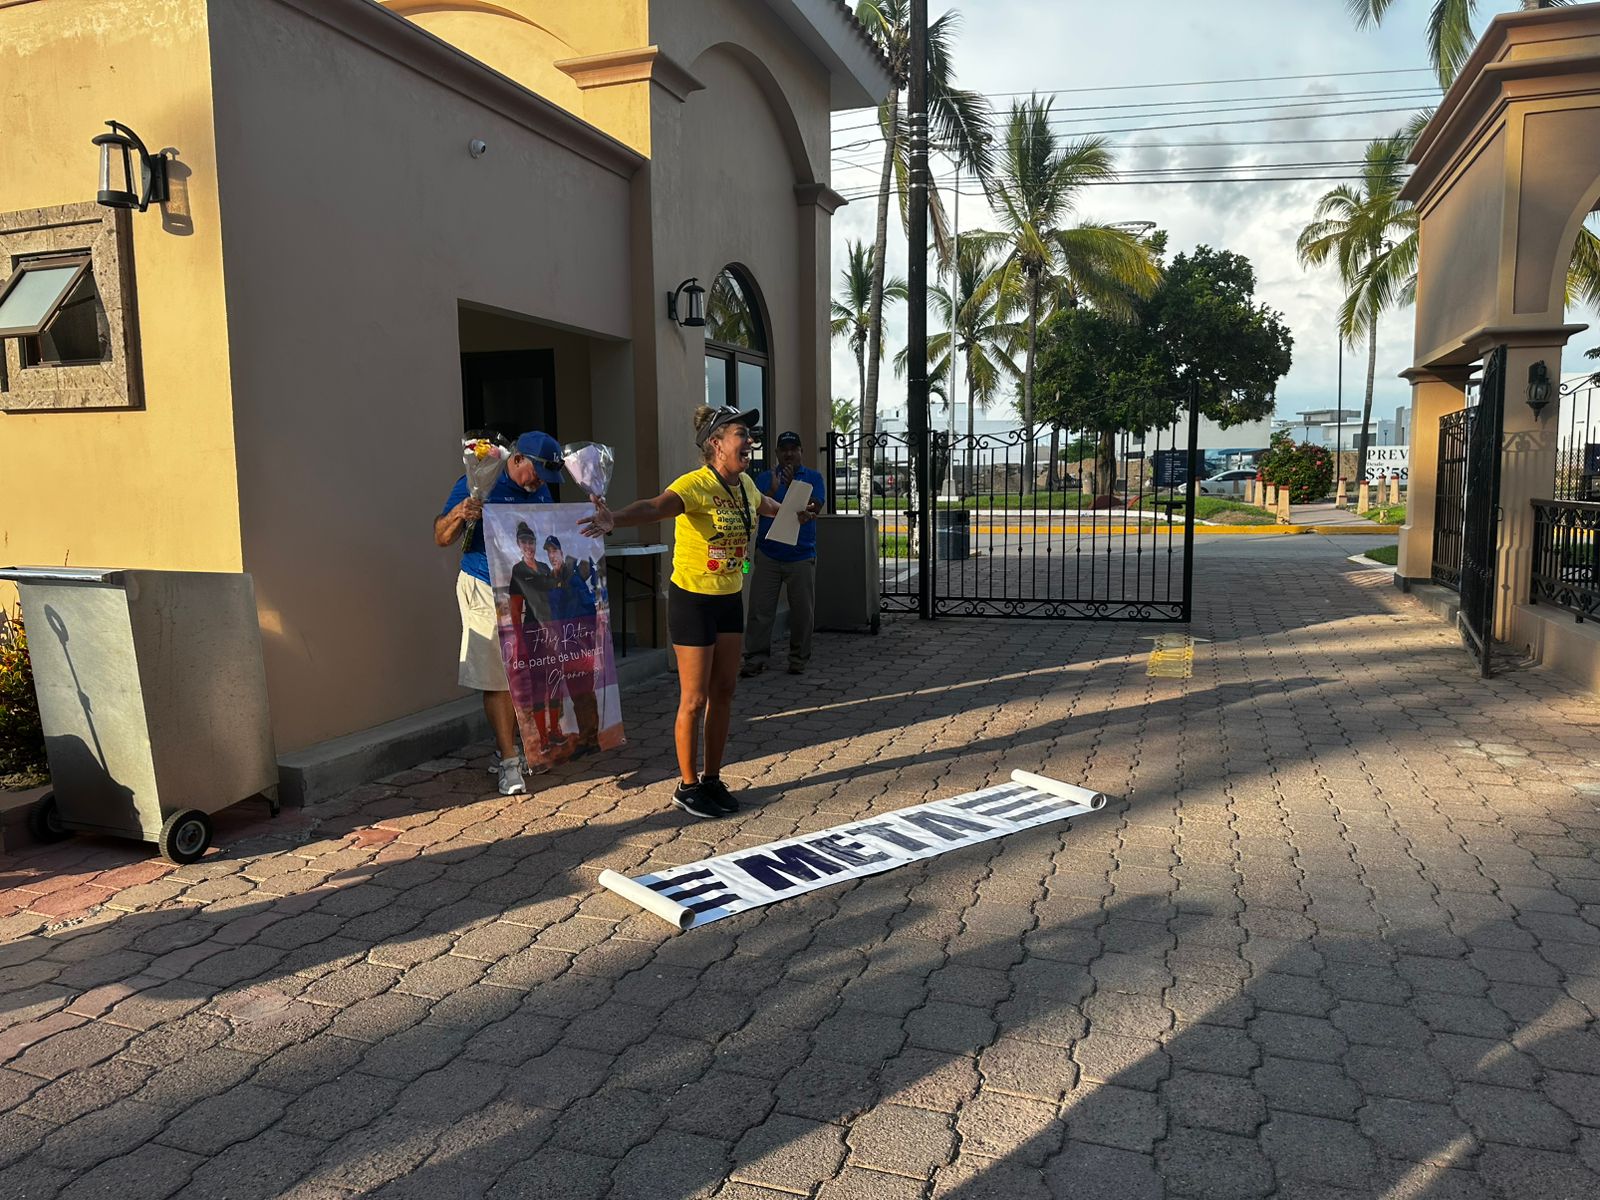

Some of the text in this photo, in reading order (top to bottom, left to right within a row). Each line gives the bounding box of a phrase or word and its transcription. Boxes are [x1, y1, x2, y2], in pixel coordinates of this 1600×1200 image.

[512, 657, 525, 670] de
[529, 654, 556, 670] parte
[558, 652, 569, 663] de
[570, 651, 580, 660] tu
[732, 810, 996, 891] META
